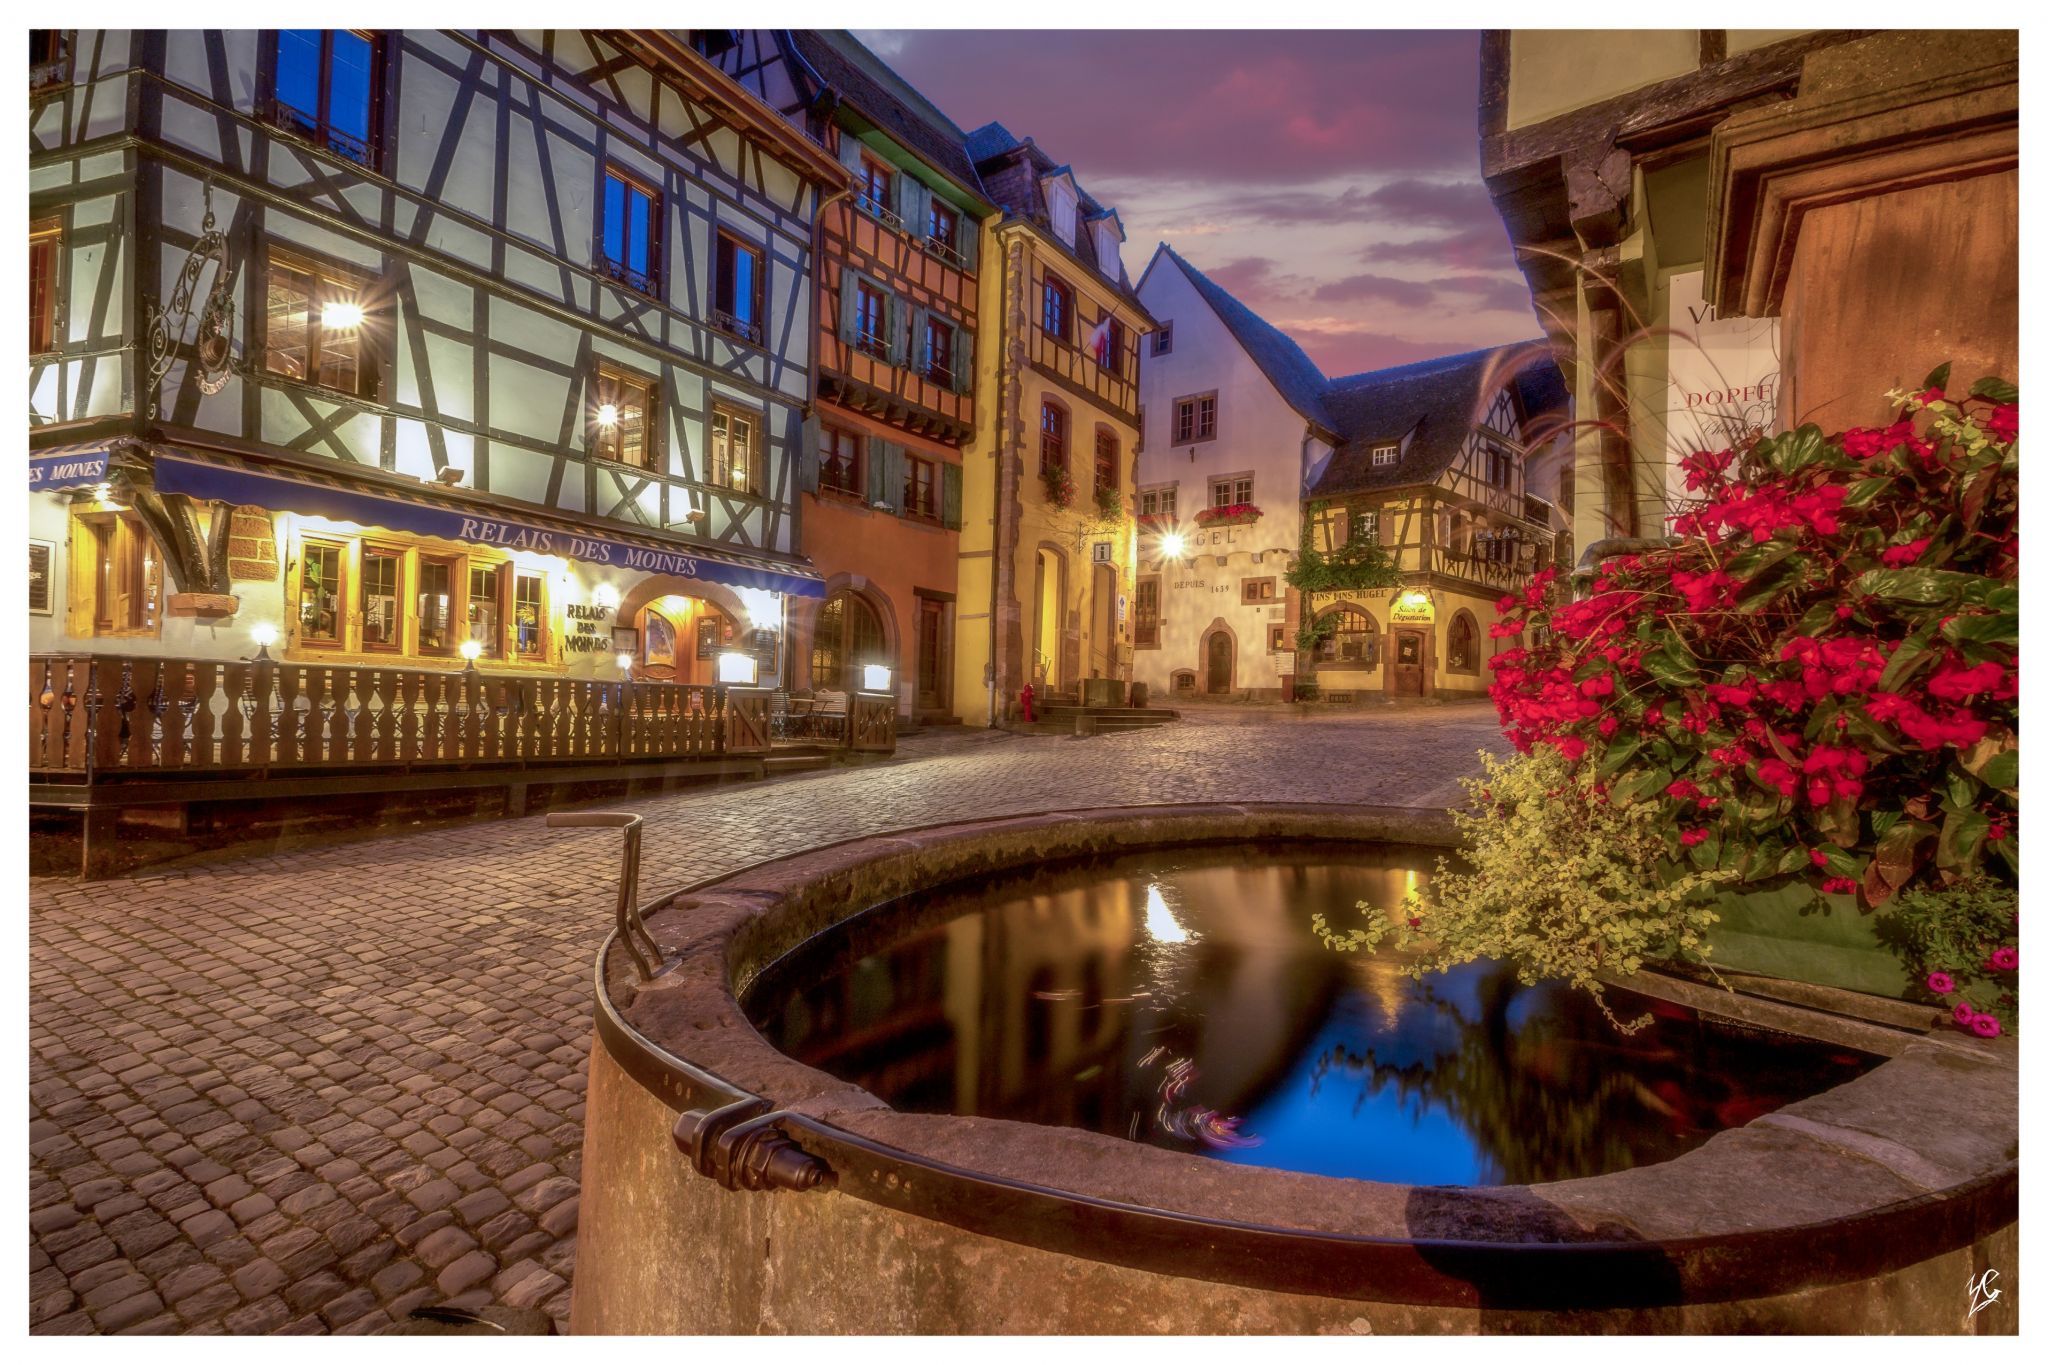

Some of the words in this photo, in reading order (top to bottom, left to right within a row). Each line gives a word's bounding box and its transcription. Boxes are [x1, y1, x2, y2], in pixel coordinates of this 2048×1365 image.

[1686, 384, 1774, 409] DOPFF
[49, 460, 104, 481] MOINES
[459, 517, 553, 552] RELAIS
[569, 538, 611, 562] DES
[624, 548, 697, 576] MOINES
[1196, 528, 1236, 546] GEL
[1174, 580, 1206, 590] DEPUIS
[1211, 584, 1230, 594] 1639
[1356, 588, 1386, 599] HUGEL
[566, 603, 607, 622] RELAIS
[577, 621, 597, 634] DES
[564, 634, 608, 653] MOINES
